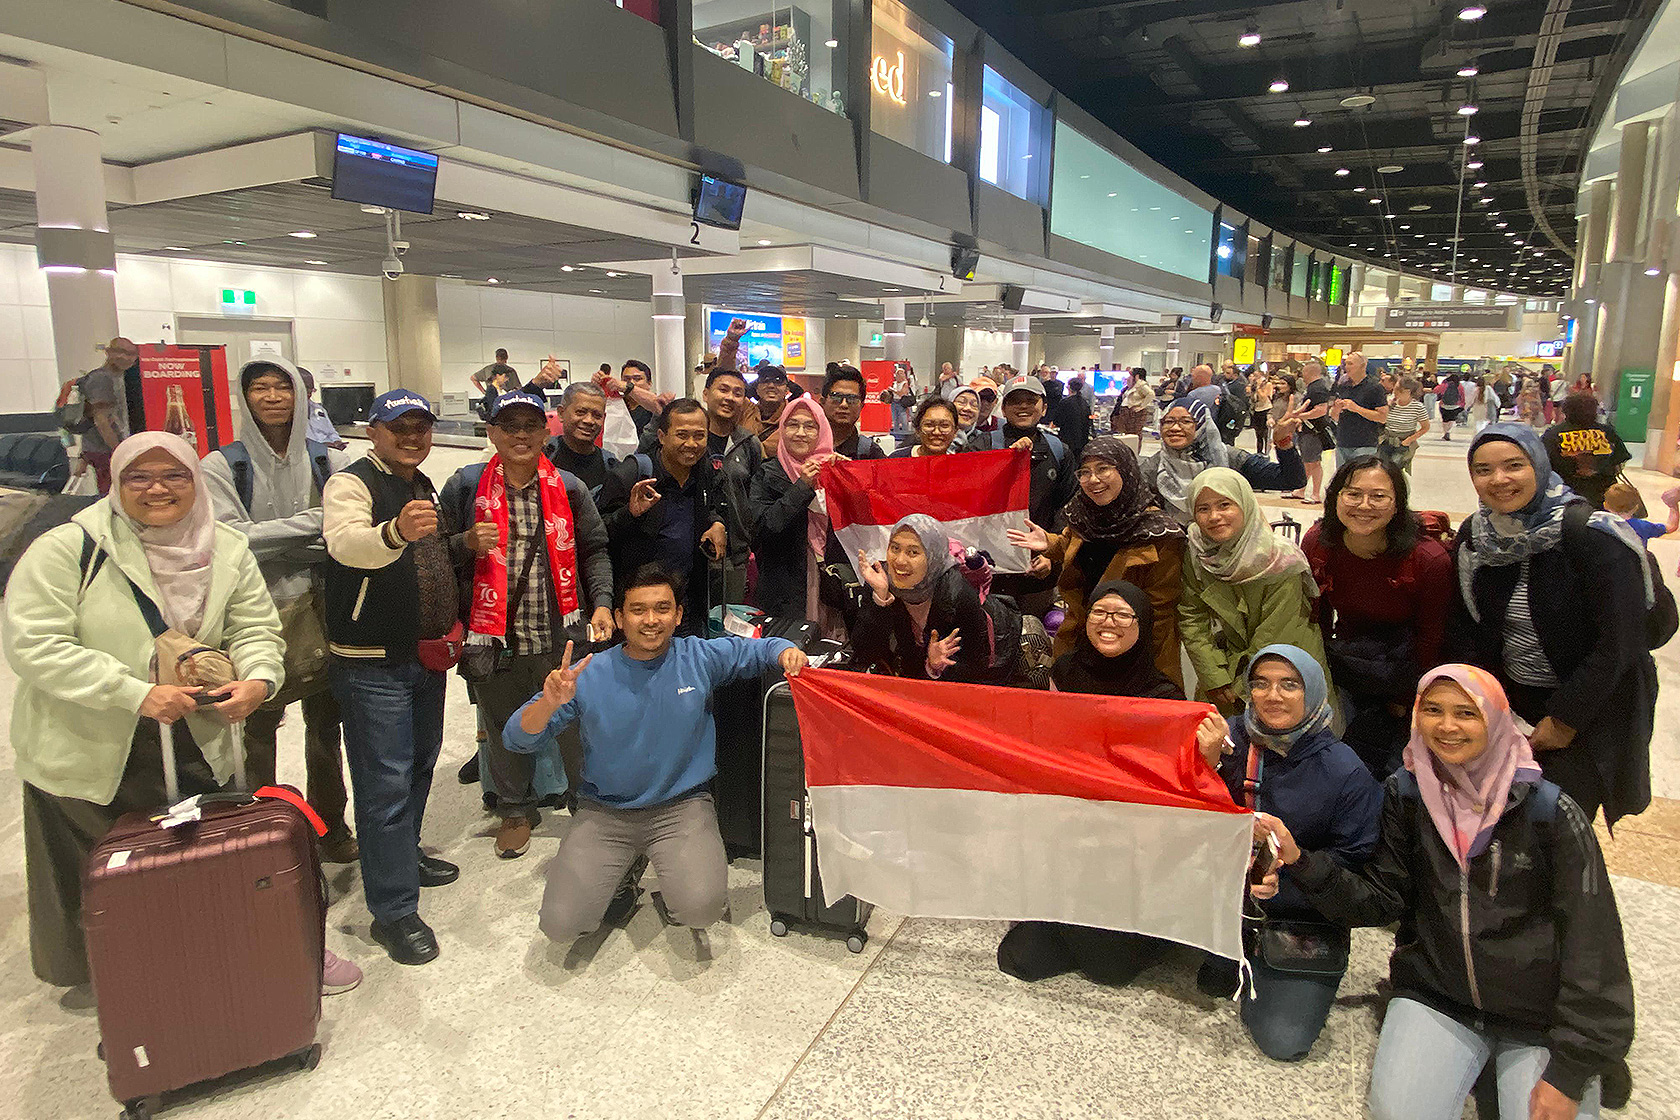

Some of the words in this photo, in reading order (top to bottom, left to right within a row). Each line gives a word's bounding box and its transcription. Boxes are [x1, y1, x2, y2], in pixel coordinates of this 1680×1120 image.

[690, 222, 700, 245] 2
[939, 275, 945, 290] 2
[1240, 345, 1249, 357] 2
[158, 362, 185, 370] NOW
[143, 370, 201, 379] BOARDING
[1558, 429, 1607, 444] TEDDY
[1560, 438, 1613, 456] SWIMS
